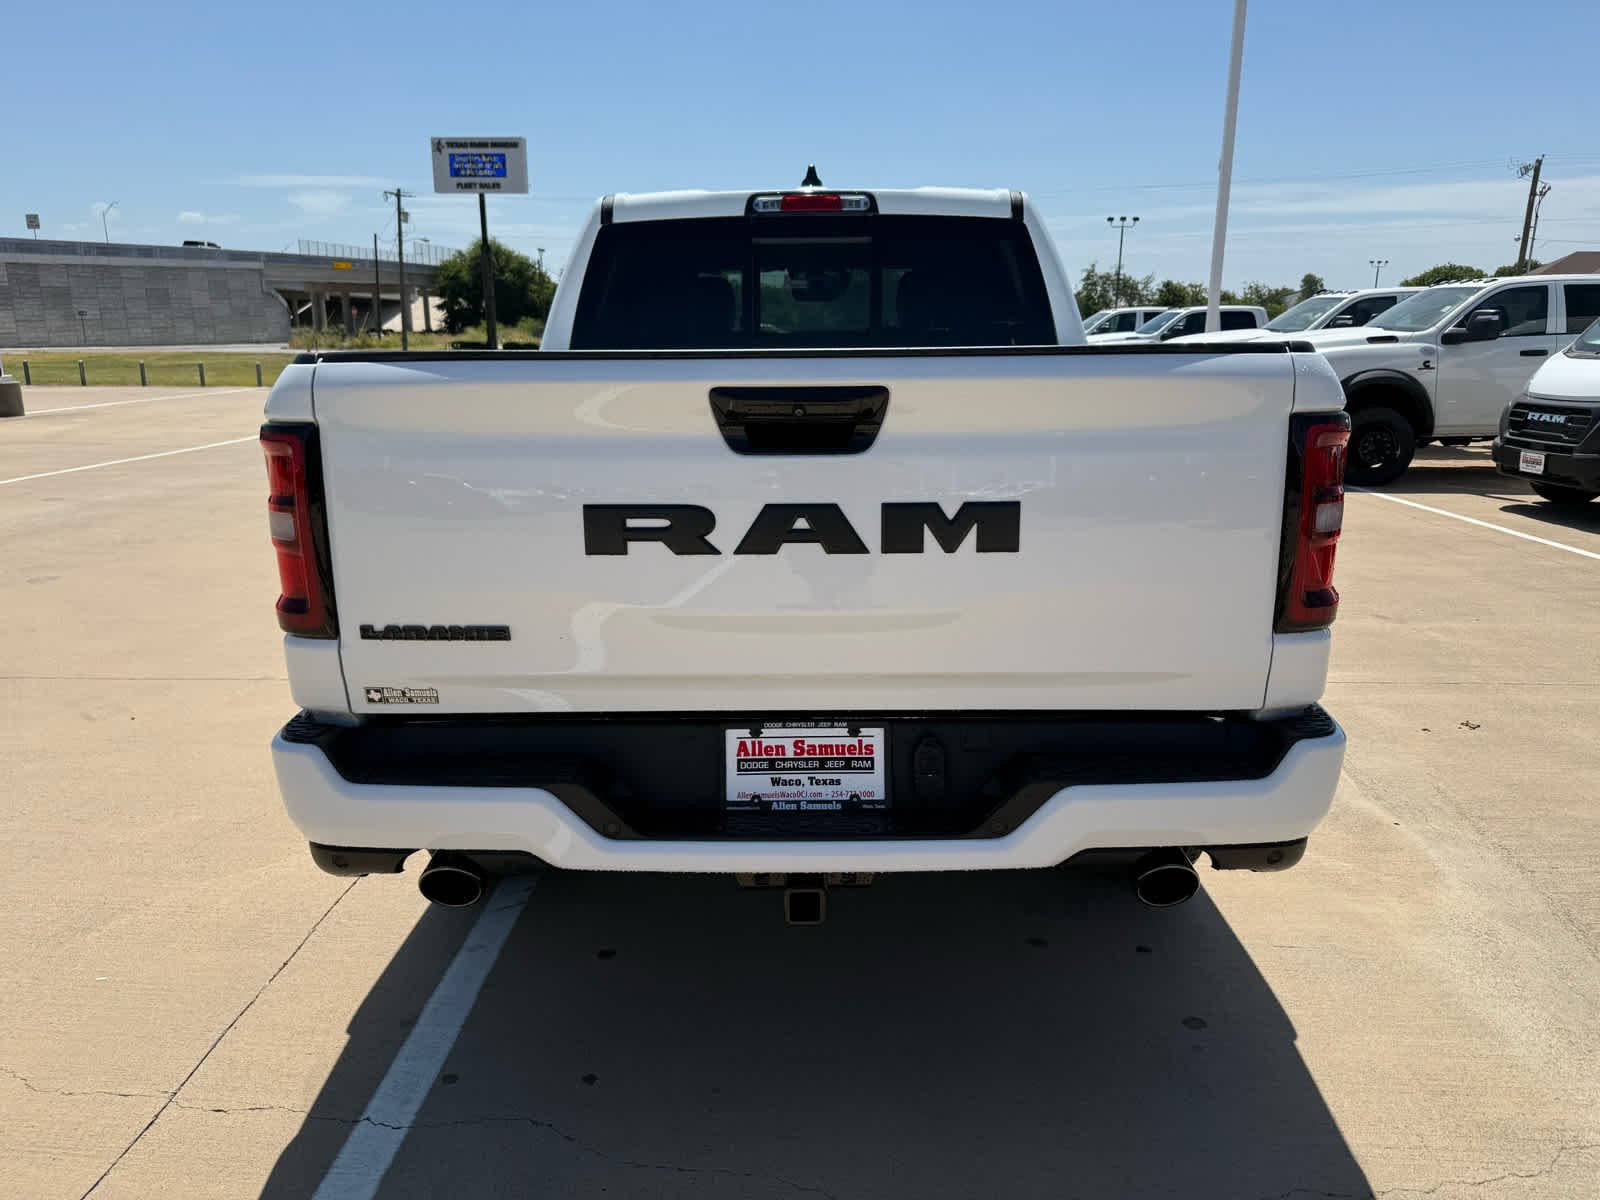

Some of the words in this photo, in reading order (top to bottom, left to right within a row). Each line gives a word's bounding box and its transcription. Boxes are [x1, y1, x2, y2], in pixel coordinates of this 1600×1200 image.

[1527, 411, 1568, 424] RAM
[583, 500, 1021, 556] RAM
[360, 624, 511, 641] LARAMIE
[383, 687, 403, 697] Allen
[405, 688, 438, 698] Samuels
[736, 740, 786, 758] Allen
[793, 739, 874, 757] Samuels
[740, 761, 769, 770] DODGE
[775, 760, 820, 770] CHRYSLER
[824, 760, 845, 769] JEEP
[851, 760, 872, 768] RAM
[770, 776, 805, 788] Waco,
[808, 776, 842, 786] Texas
[771, 801, 797, 811] Allen
[800, 801, 842, 811] Samuels
